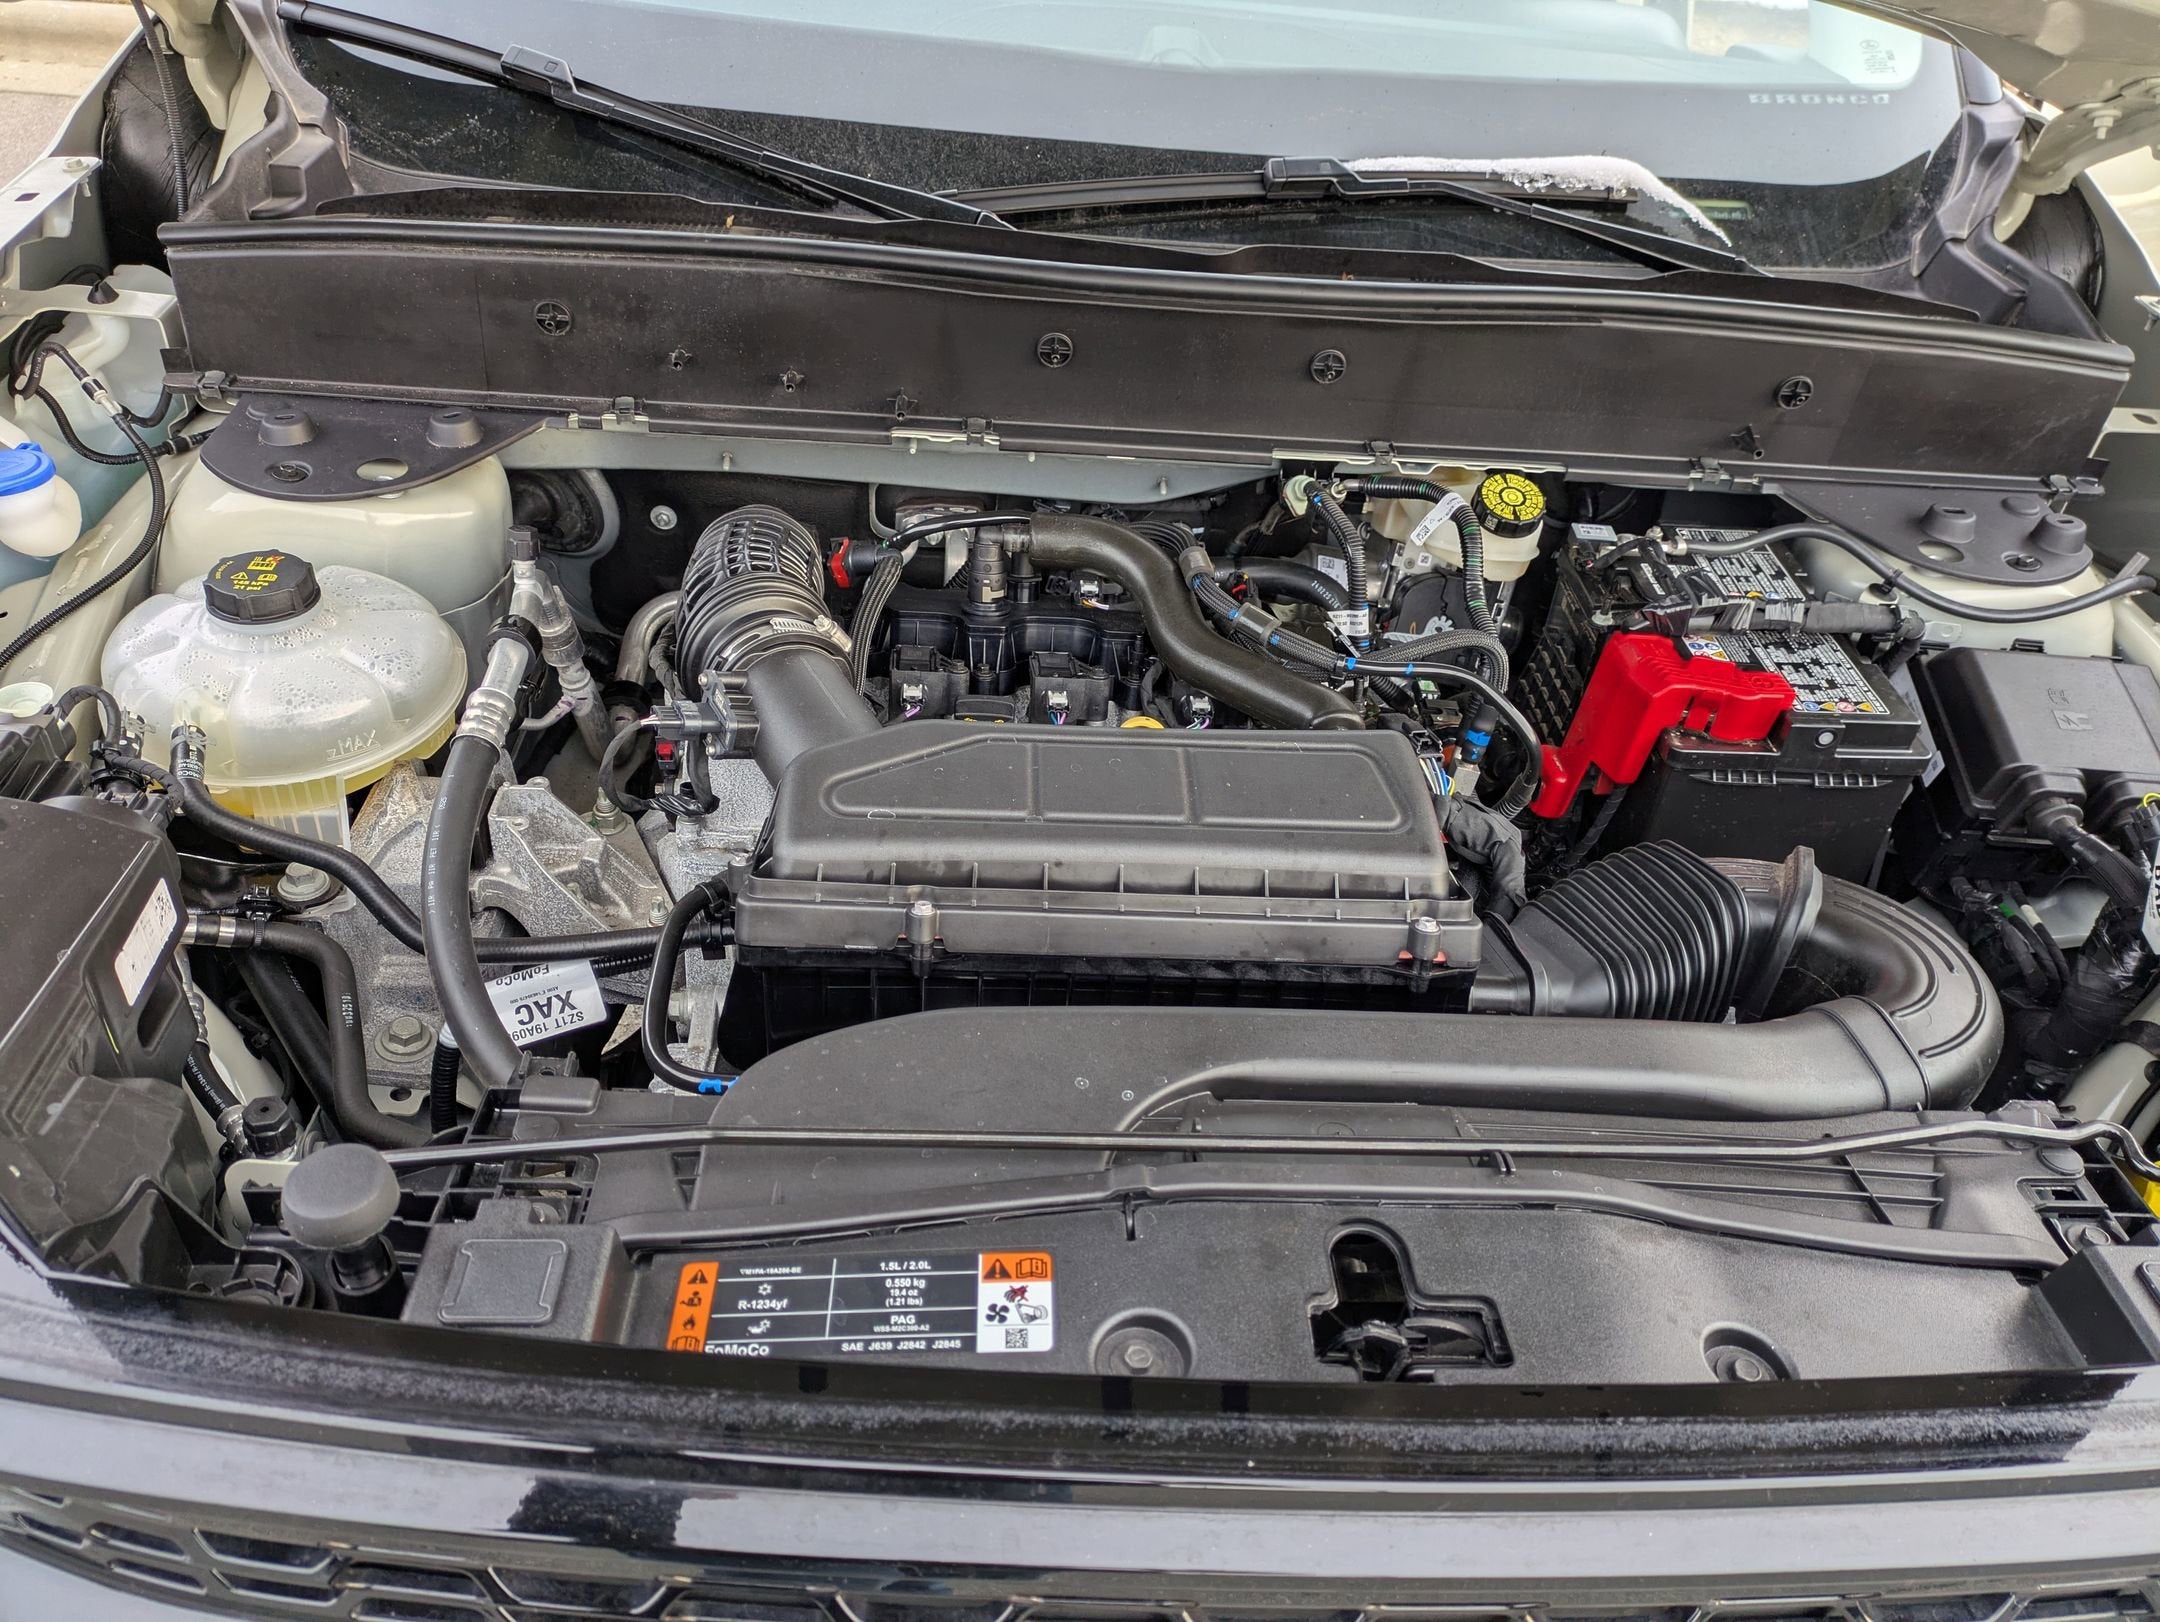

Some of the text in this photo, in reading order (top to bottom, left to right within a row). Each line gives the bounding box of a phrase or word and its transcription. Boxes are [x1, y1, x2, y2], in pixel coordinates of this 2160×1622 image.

[1749, 93, 1890, 104] BRONCO
[495, 964, 550, 986] FoMoCo
[514, 990, 577, 1026] XAC
[554, 1011, 585, 1028] SZ1T
[880, 1261, 902, 1271] 1.5L
[909, 1261, 931, 1270] 2.0L
[885, 1277, 926, 1288] 0.550 kg
[738, 1298, 788, 1310] R-1234yf
[885, 1297, 923, 1307] (1.21 lbs)
[890, 1315, 916, 1324] PAG
[704, 1343, 770, 1356] FoMoCo
[841, 1342, 864, 1352] SAE
[868, 1341, 893, 1351] J639
